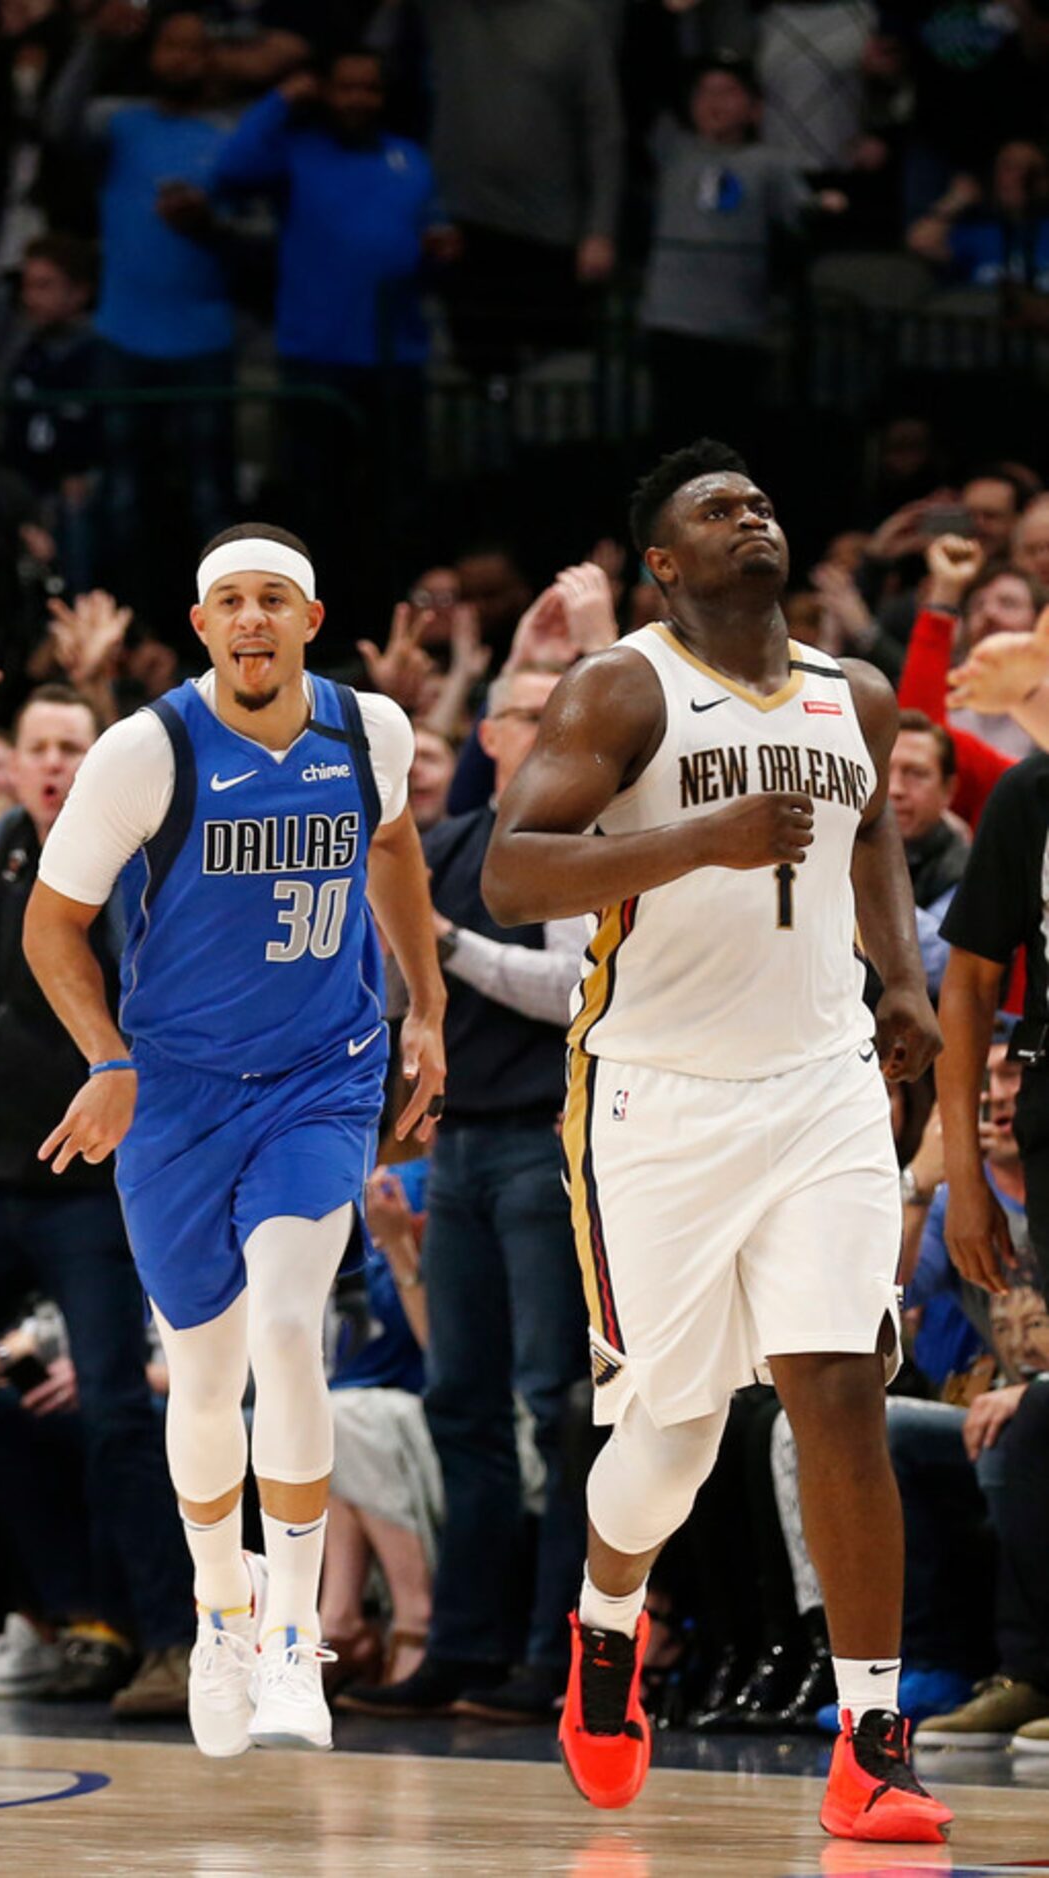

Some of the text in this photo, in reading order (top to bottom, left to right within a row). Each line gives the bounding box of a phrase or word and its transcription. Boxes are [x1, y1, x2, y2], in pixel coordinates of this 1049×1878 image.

[302, 762, 350, 782] chime
[679, 744, 868, 811] NEW ORLEANS
[203, 812, 359, 874] DALLAS
[265, 877, 352, 962] 30
